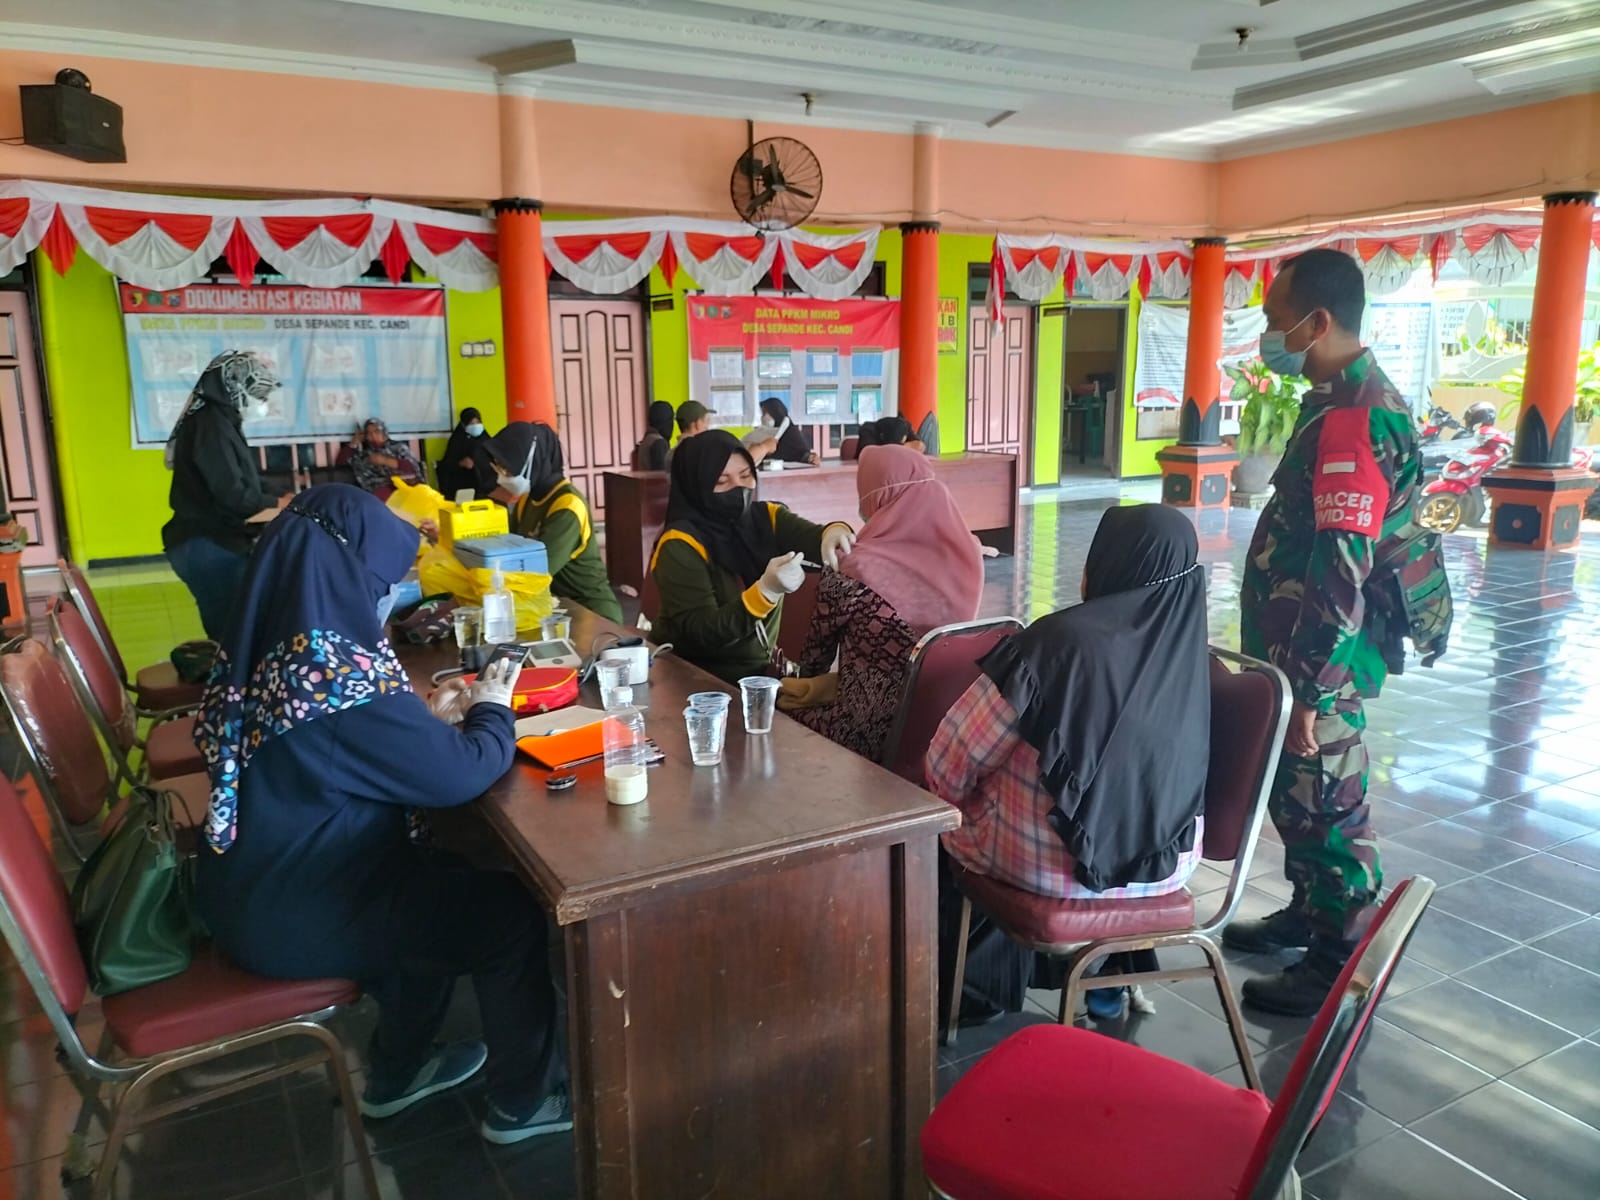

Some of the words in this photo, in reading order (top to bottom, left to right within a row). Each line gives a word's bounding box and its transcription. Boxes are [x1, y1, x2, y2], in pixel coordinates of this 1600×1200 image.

[184, 289, 290, 309] DOKUMENTASI
[293, 290, 362, 310] KEGIATAN
[755, 308, 779, 318] DATA
[274, 318, 302, 329] DESA
[304, 319, 351, 330] SEPANDE
[353, 319, 377, 329] KEC.
[379, 319, 411, 331] CANDI
[742, 323, 765, 334] DESA
[766, 323, 804, 334] SEPANDE
[827, 324, 854, 335] CANDI
[1314, 491, 1374, 511] RACER
